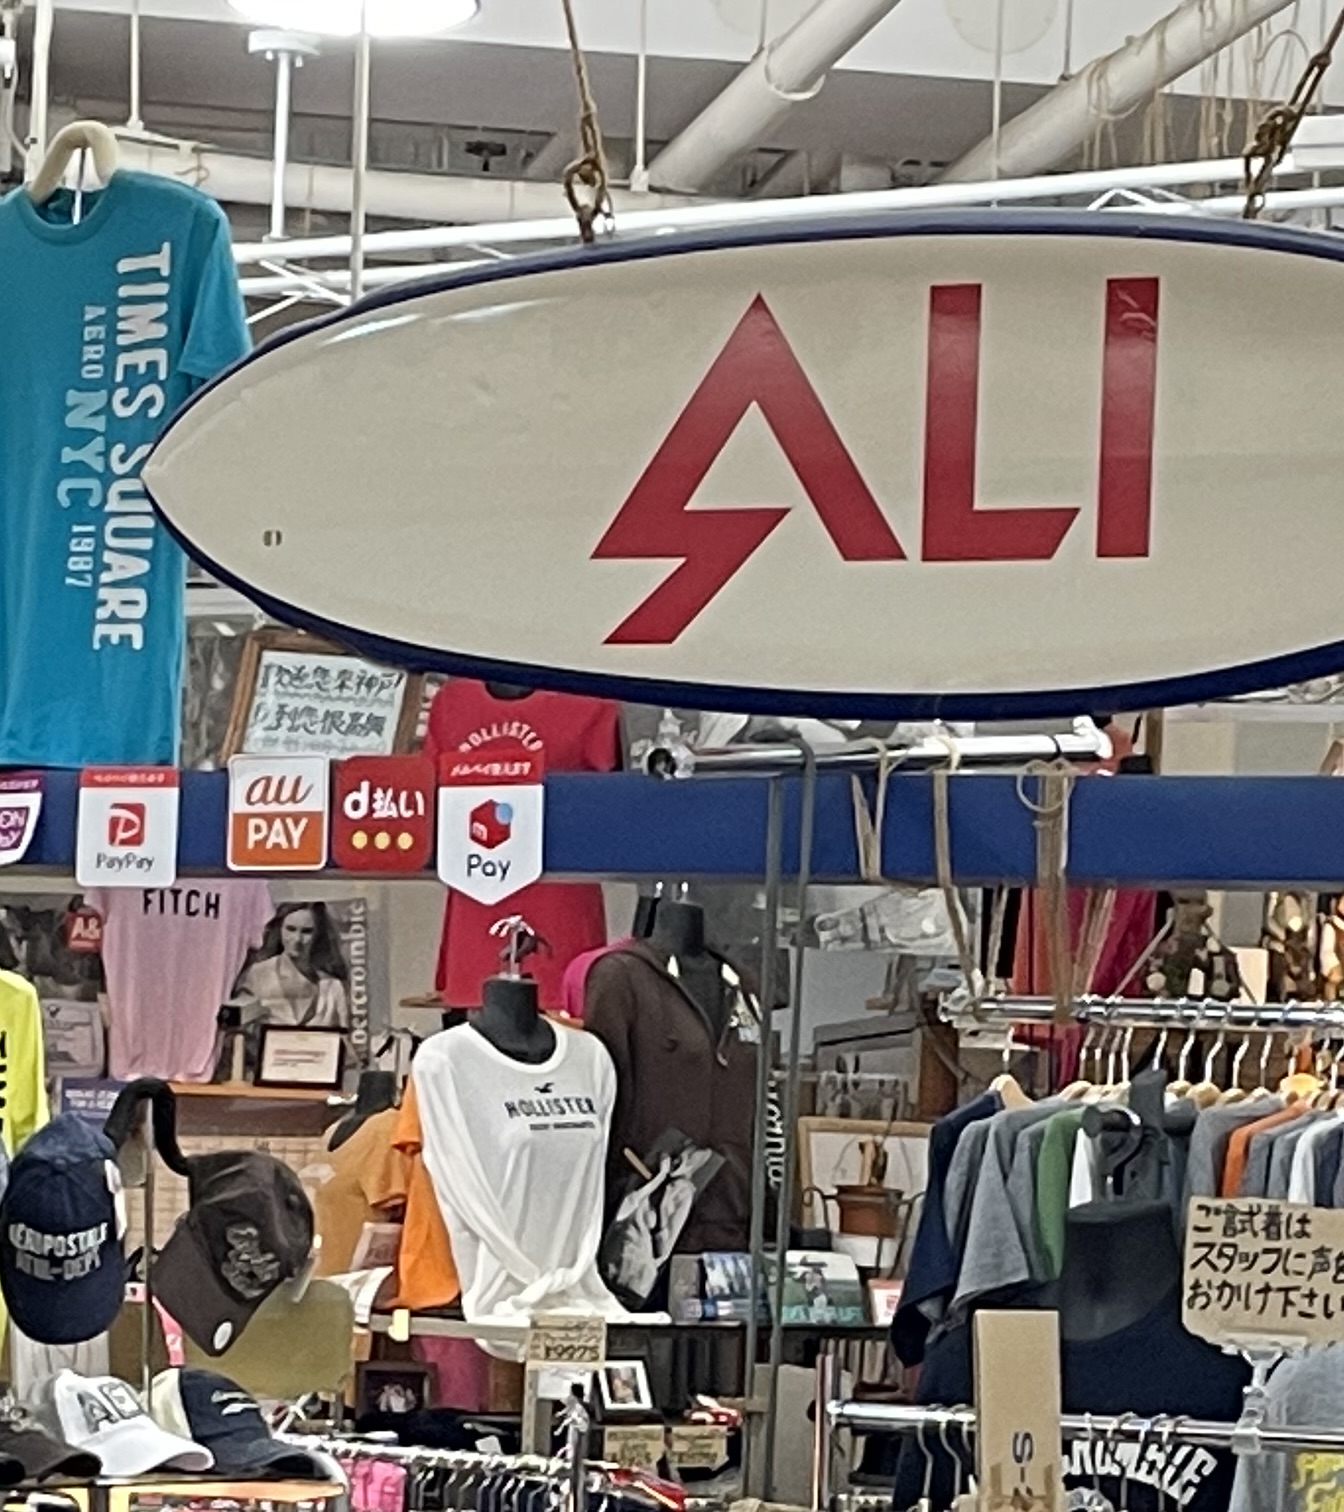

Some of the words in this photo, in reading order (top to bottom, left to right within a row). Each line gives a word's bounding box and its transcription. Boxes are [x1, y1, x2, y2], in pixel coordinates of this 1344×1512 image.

[81, 305, 106, 379] AERO
[112, 241, 171, 419] TIMES
[58, 389, 108, 509] NYC
[589, 276, 1160, 645] ALI
[246, 775, 313, 806] au
[343, 780, 425, 820] d払い
[248, 816, 308, 850] PAY
[95, 852, 155, 873] PayPay
[466, 853, 512, 882] Pay
[142, 888, 221, 920] FITCH
[505, 1097, 596, 1119] HOLLISTER
[1192, 1203, 1312, 1241] ご試着は
